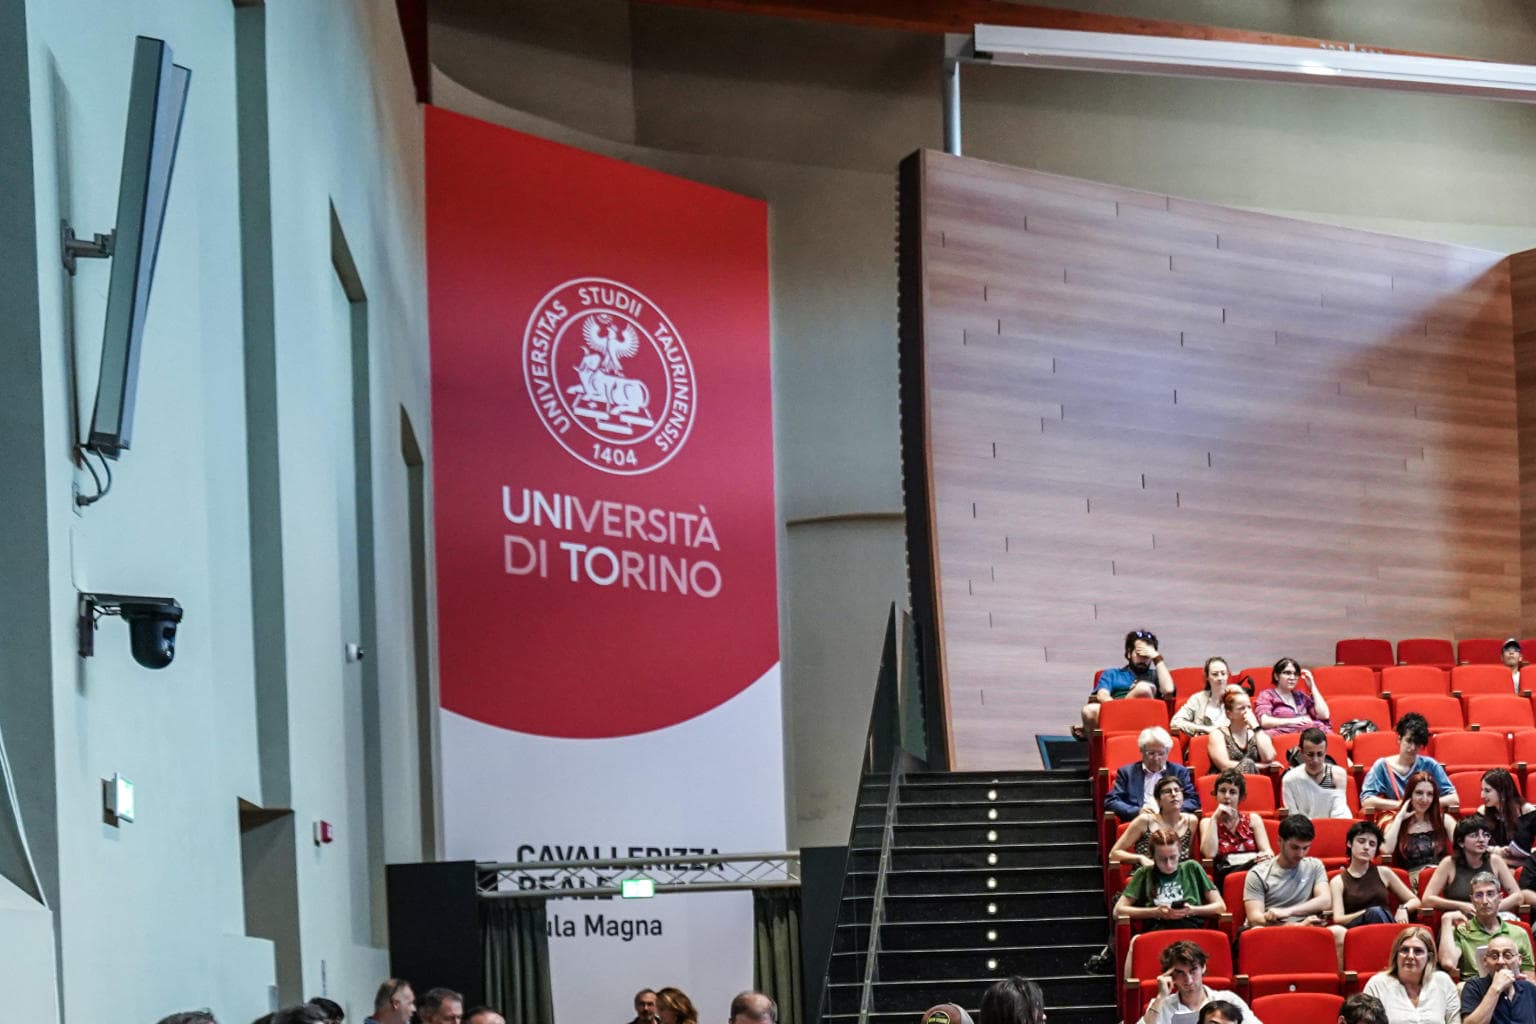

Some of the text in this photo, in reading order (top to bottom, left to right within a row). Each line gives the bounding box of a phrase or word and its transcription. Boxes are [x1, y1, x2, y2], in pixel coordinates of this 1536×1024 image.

[530, 287, 689, 452] UNIVERSITAS STUDII TAURINENSIS
[592, 443, 638, 466] 1404
[502, 484, 720, 551] UNIVERSITÀ
[504, 534, 722, 598] DI TORINO
[585, 914, 663, 942] Magna
